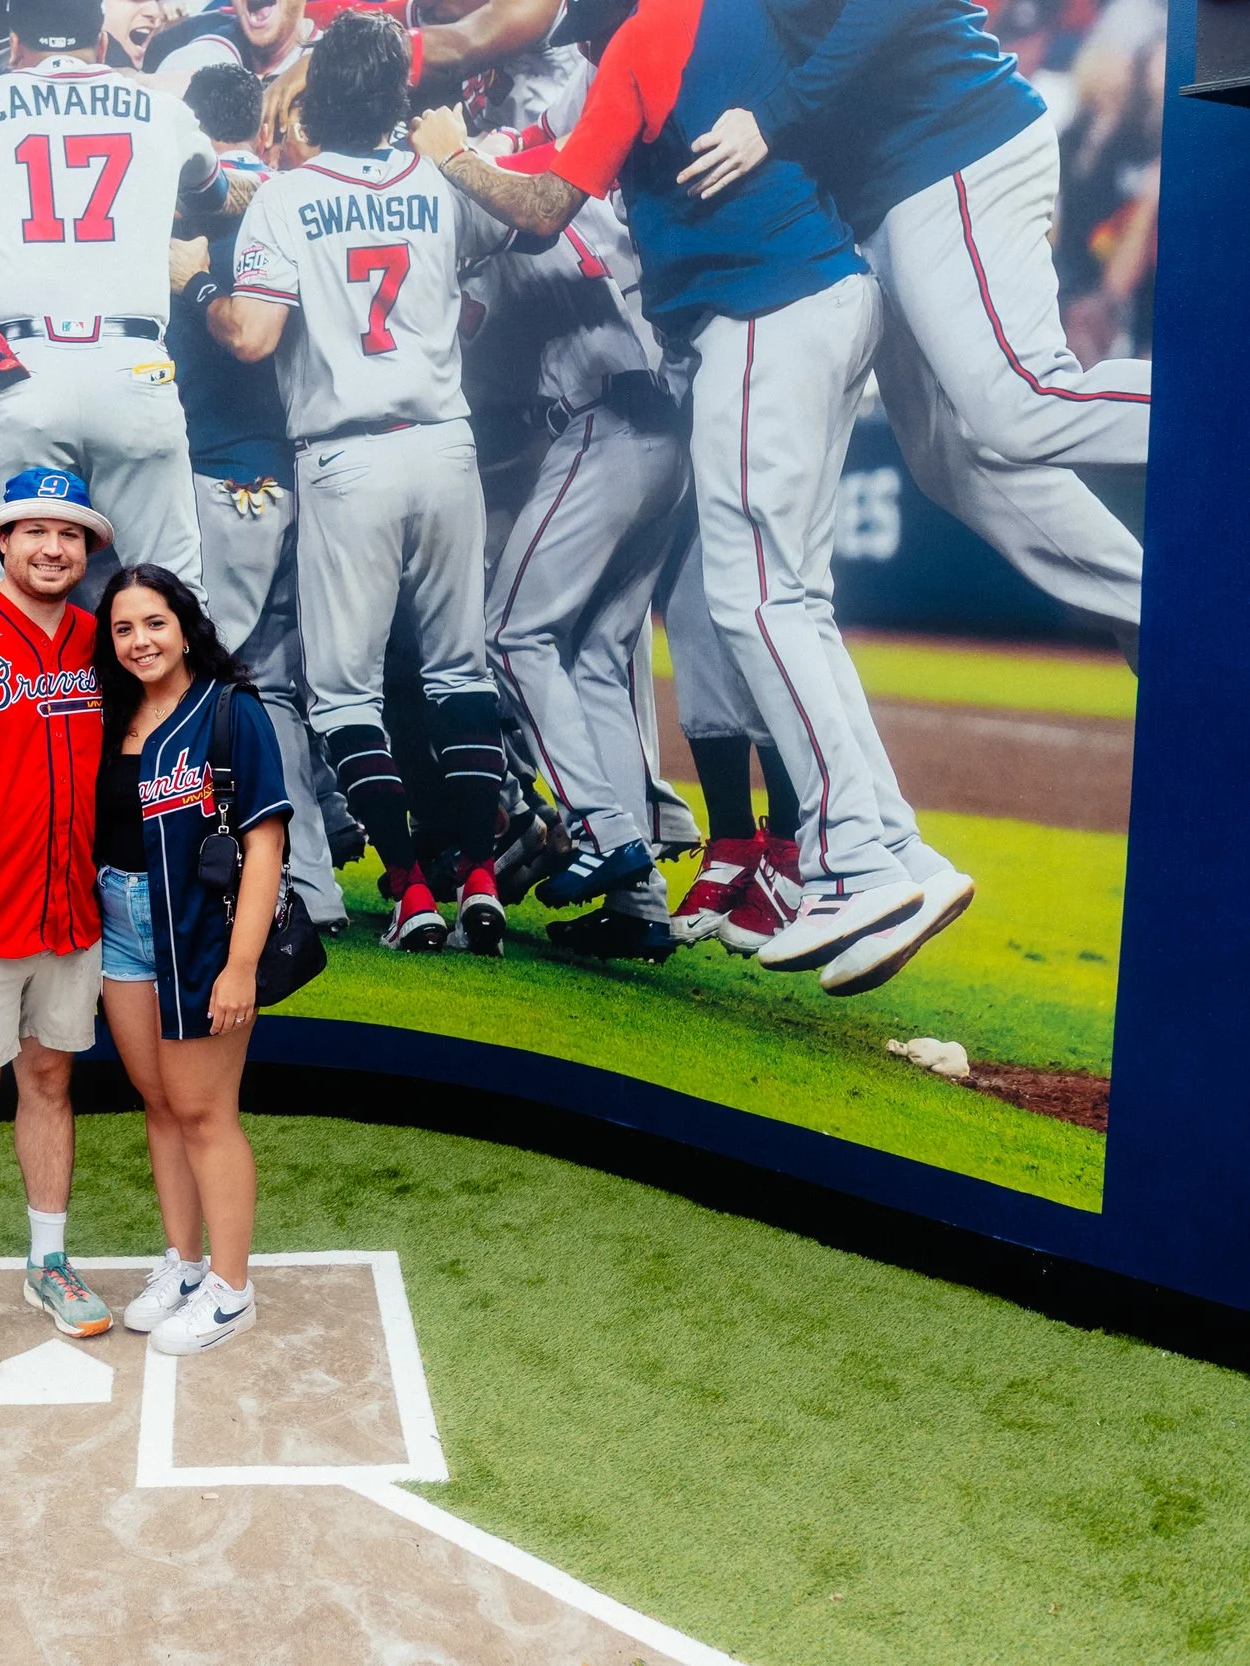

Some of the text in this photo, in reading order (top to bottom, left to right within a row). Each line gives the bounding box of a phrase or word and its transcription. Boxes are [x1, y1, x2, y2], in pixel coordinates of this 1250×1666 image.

[15, 133, 133, 243] 17
[299, 194, 438, 241] SWANSON
[347, 243, 411, 356] 7
[37, 475, 70, 498] 9
